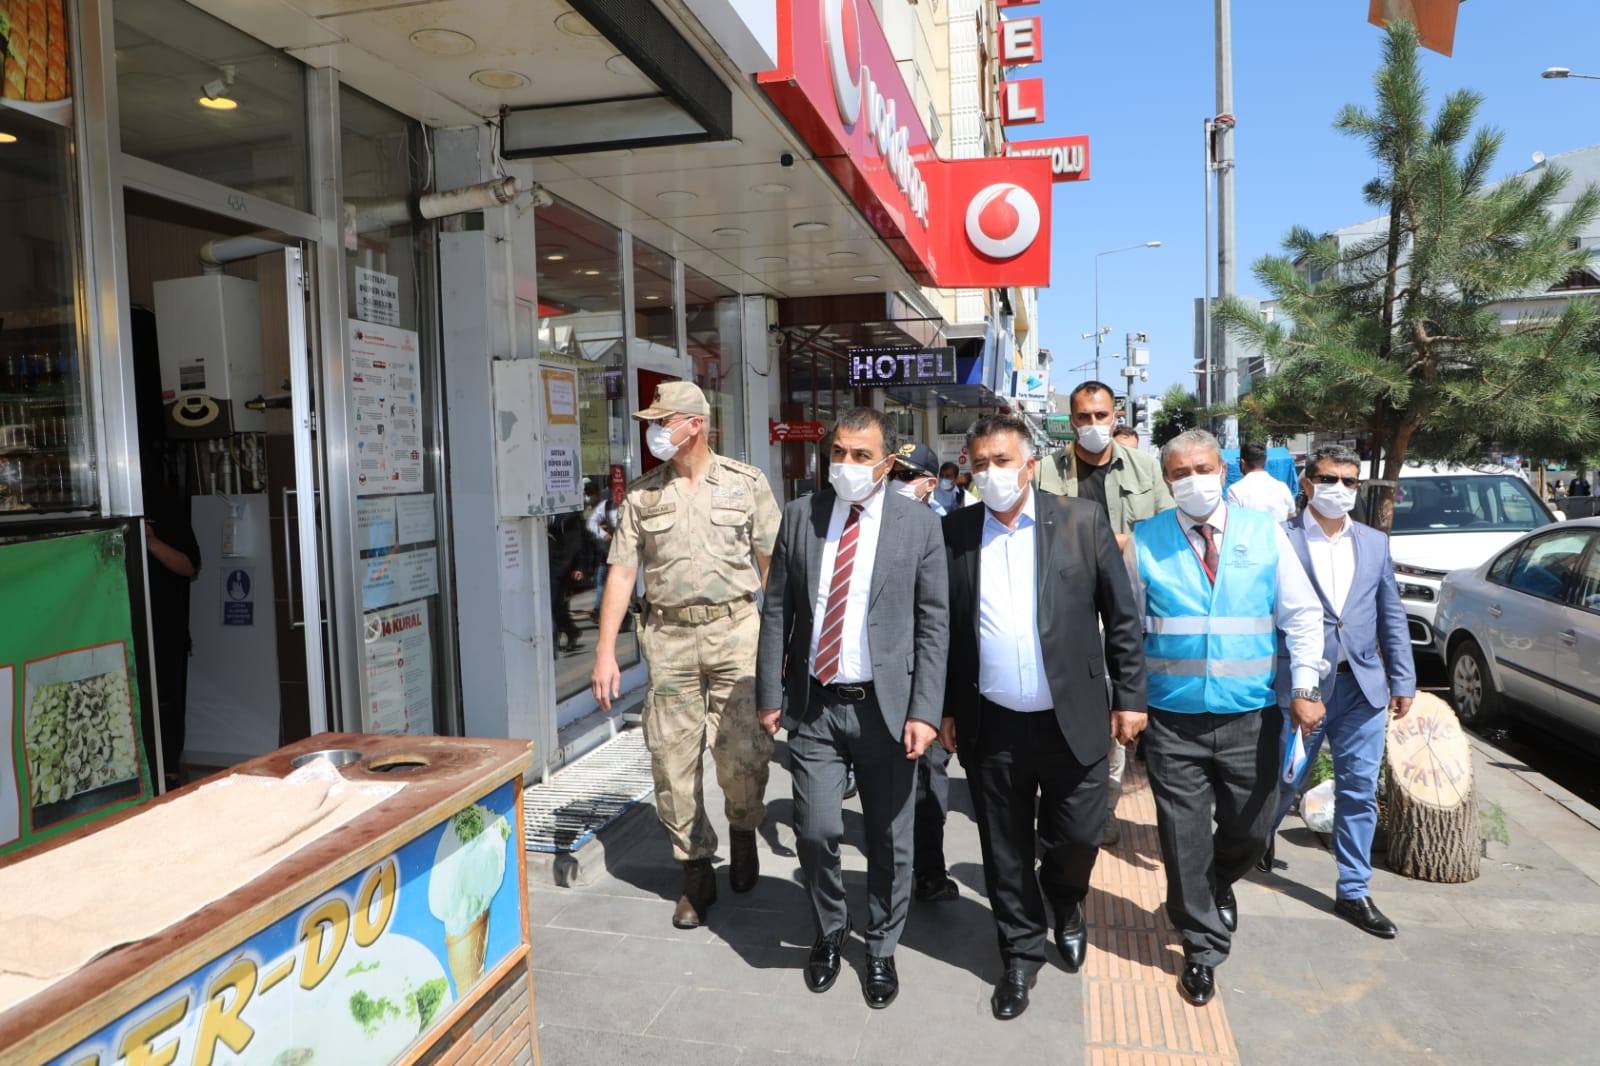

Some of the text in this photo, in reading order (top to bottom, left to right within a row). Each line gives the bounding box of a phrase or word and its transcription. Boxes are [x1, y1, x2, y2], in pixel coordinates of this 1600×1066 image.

[861, 65, 929, 229] vodafone
[853, 353, 952, 380] HOTEL
[391, 613, 422, 634] KURAL
[66, 858, 396, 1066] ER-DO
